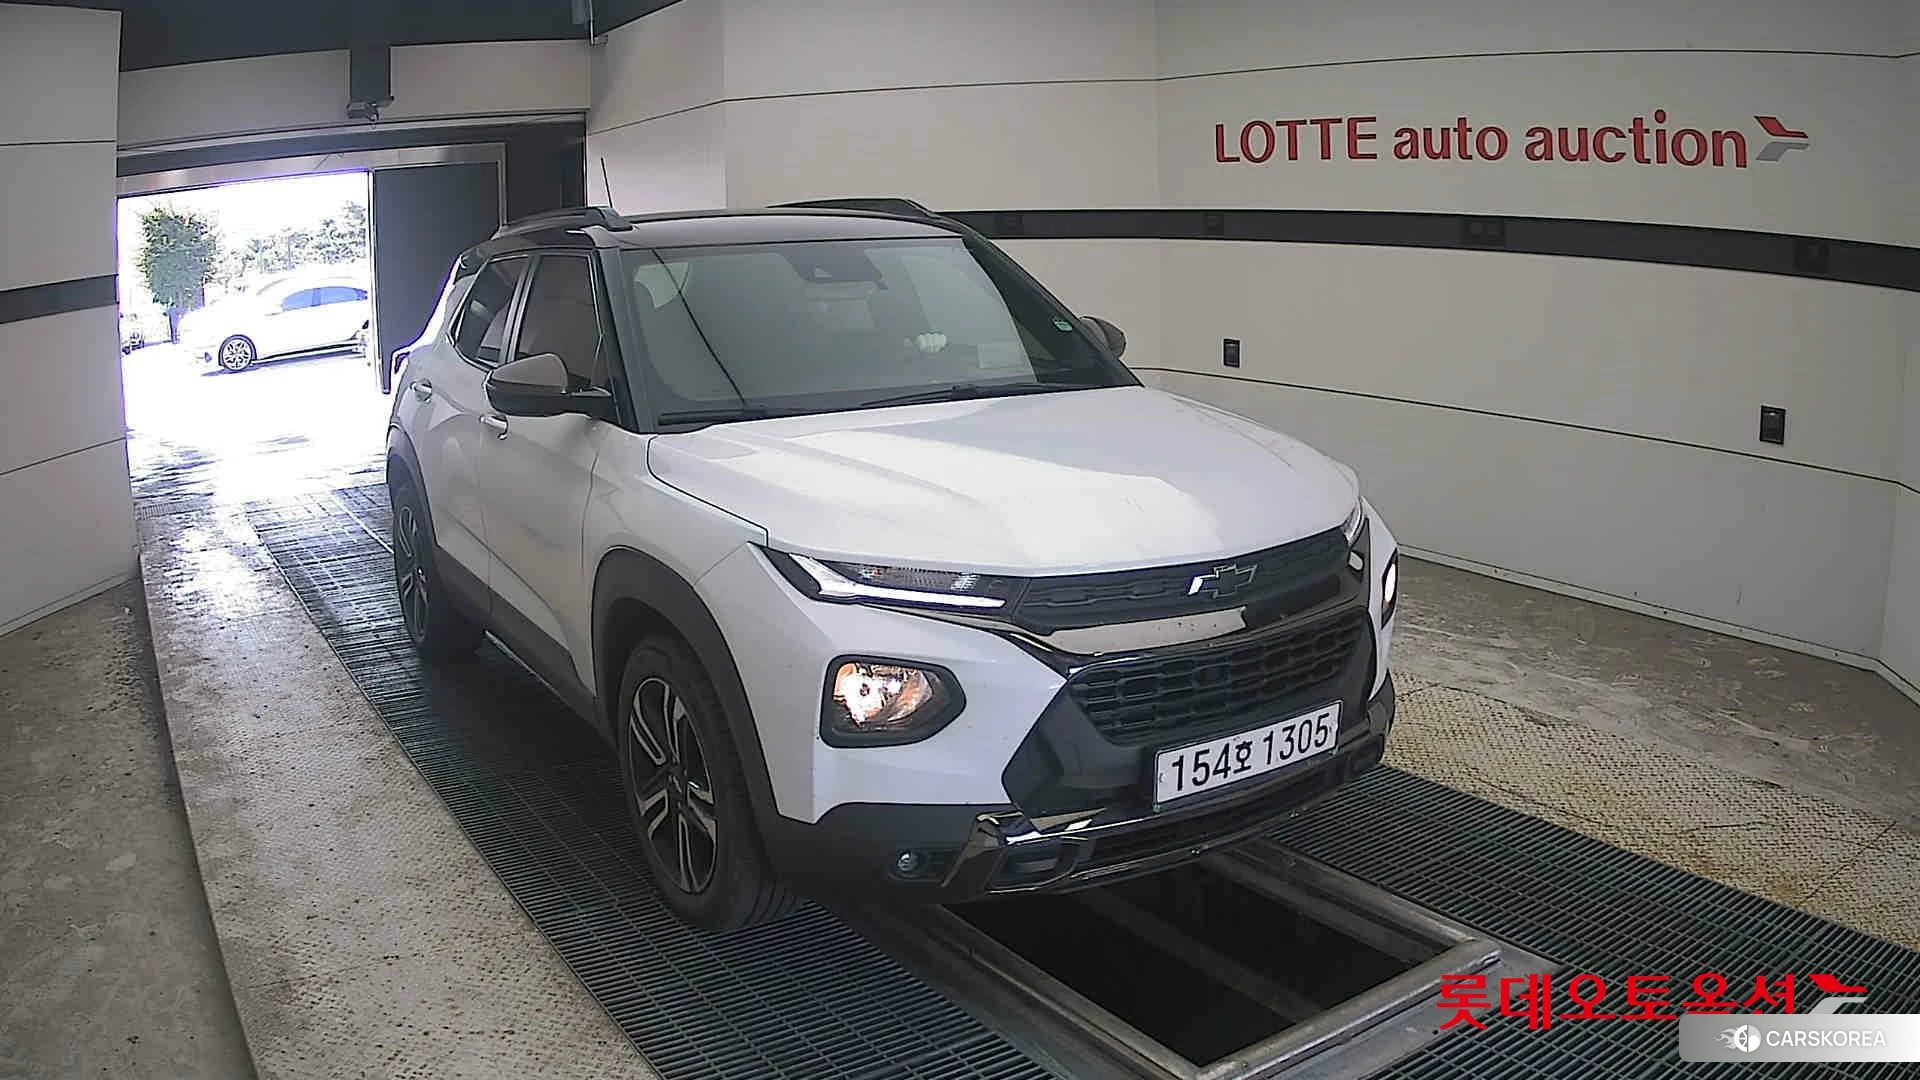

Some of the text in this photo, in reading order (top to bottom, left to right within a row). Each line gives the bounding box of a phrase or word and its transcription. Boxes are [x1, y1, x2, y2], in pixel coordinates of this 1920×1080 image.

[1215, 109, 1747, 168] LOTTE auto auction
[1171, 713, 1330, 792] 154호 1305
